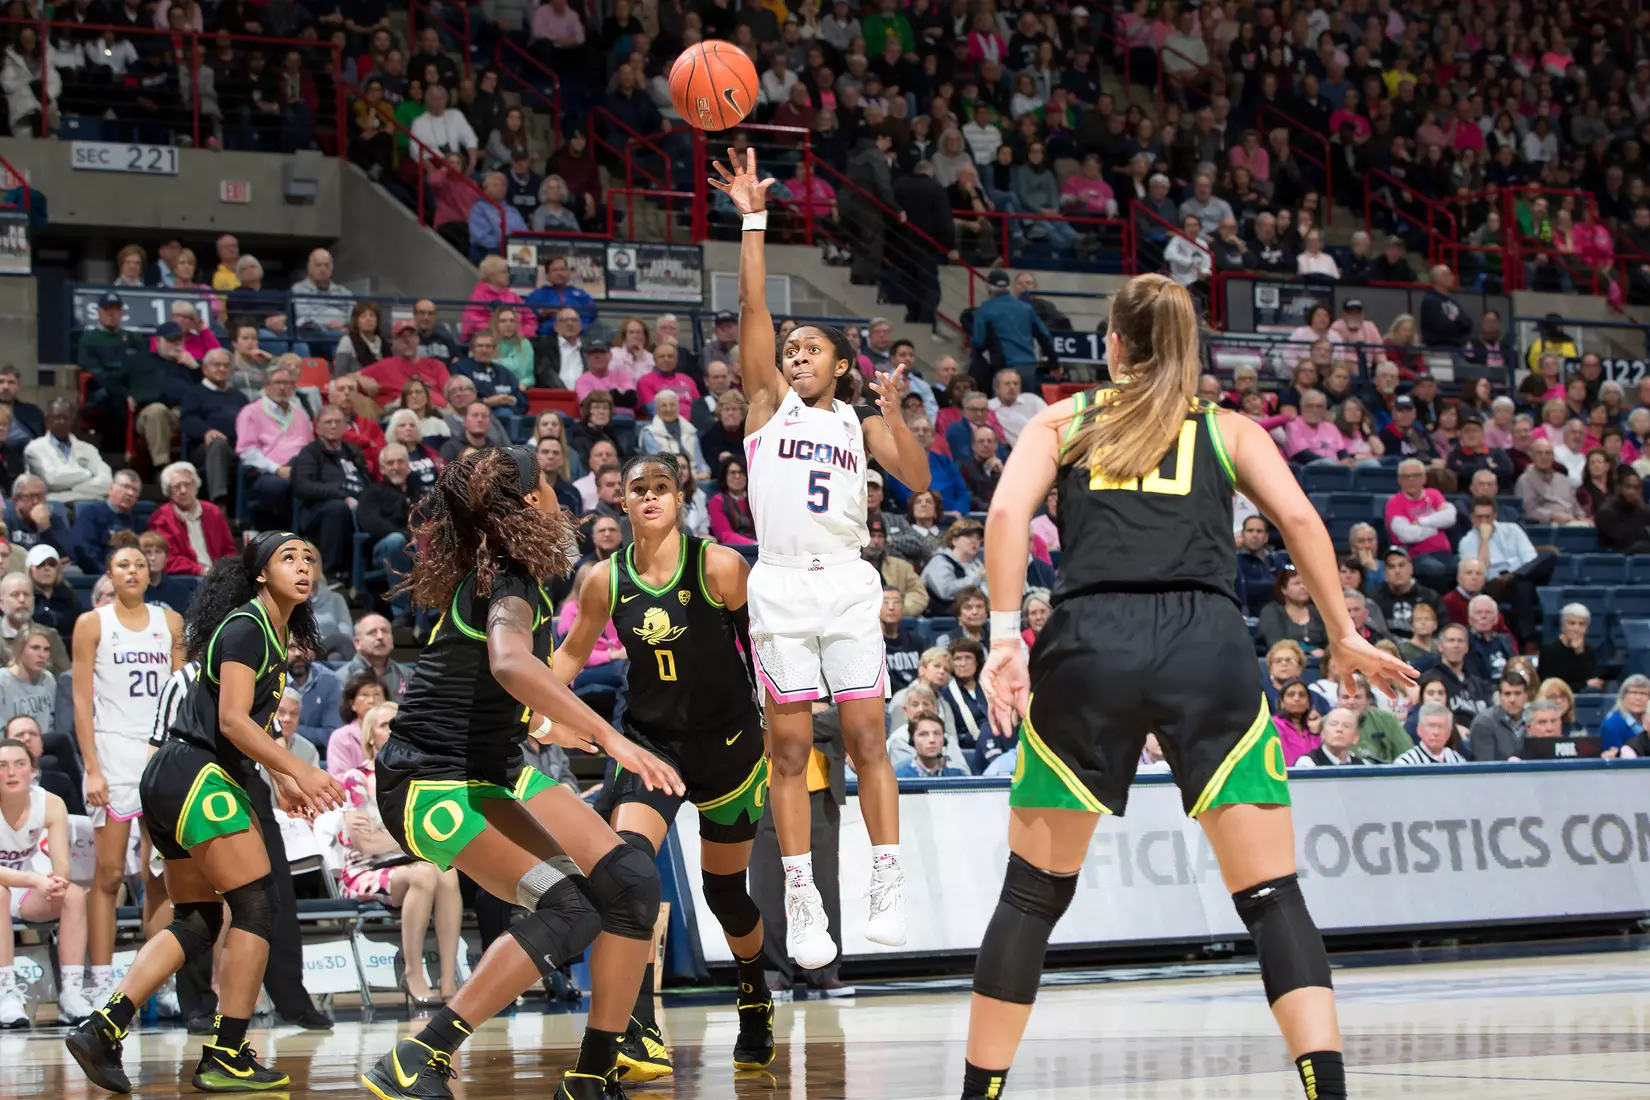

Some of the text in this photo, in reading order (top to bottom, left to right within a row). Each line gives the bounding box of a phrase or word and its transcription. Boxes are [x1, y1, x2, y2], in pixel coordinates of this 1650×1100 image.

[76, 147, 176, 171] SEC 221
[1053, 336, 1077, 354] EC
[1602, 360, 1647, 387] 122
[778, 438, 858, 474] UCONN
[807, 469, 831, 514] 5
[113, 651, 168, 665] UCONN
[654, 649, 678, 681] 0
[128, 670, 159, 697] 20
[203, 791, 239, 822] O
[423, 799, 464, 842] O
[1297, 816, 1552, 880] OGISTICS
